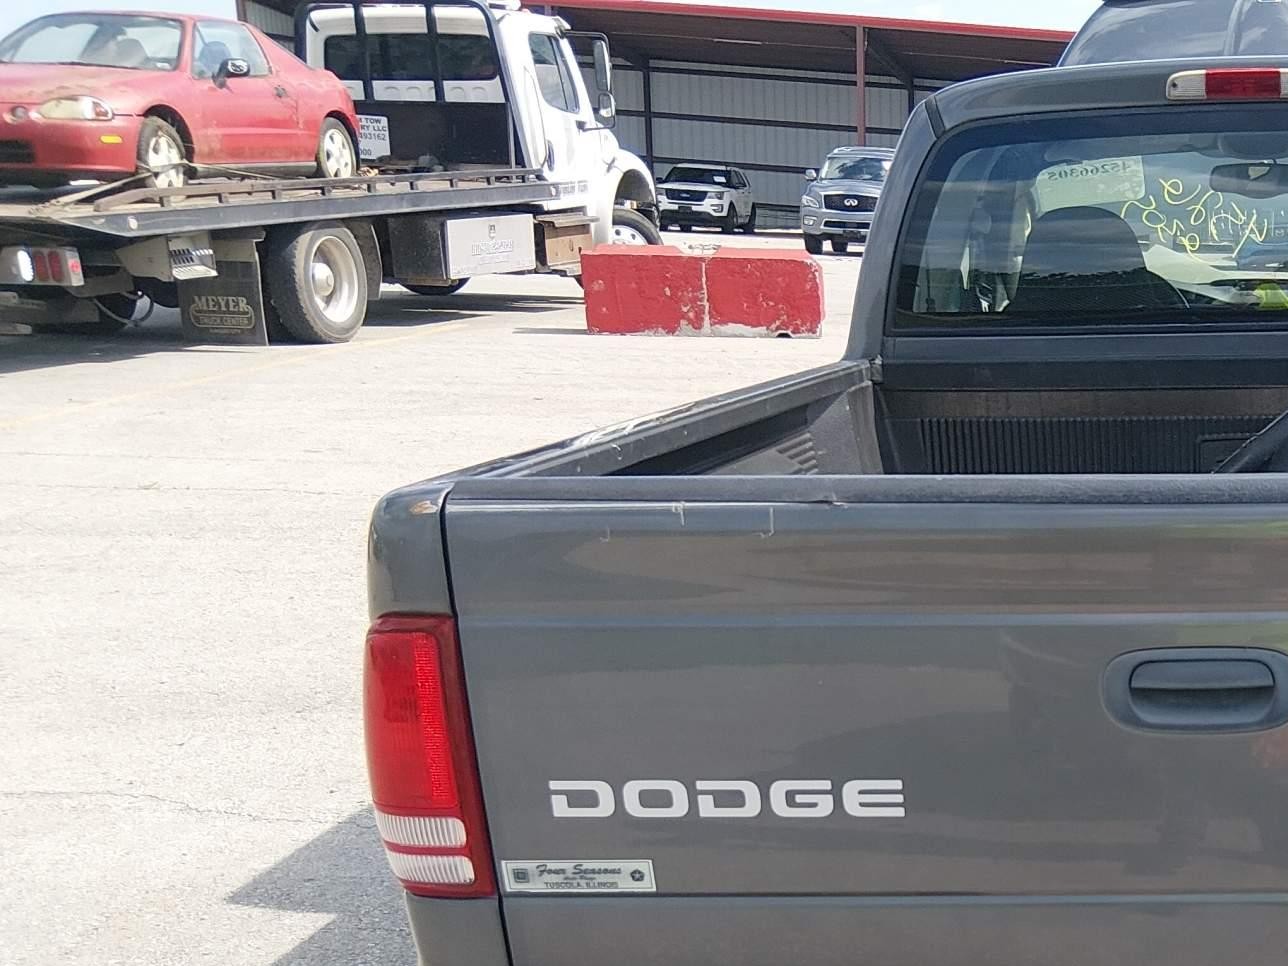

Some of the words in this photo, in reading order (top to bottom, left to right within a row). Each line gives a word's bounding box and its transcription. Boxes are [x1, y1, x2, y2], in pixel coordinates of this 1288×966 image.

[193, 296, 249, 312] MEYER
[549, 780, 905, 817] DODGE
[536, 864, 567, 877] Four
[572, 864, 622, 875] Seasons
